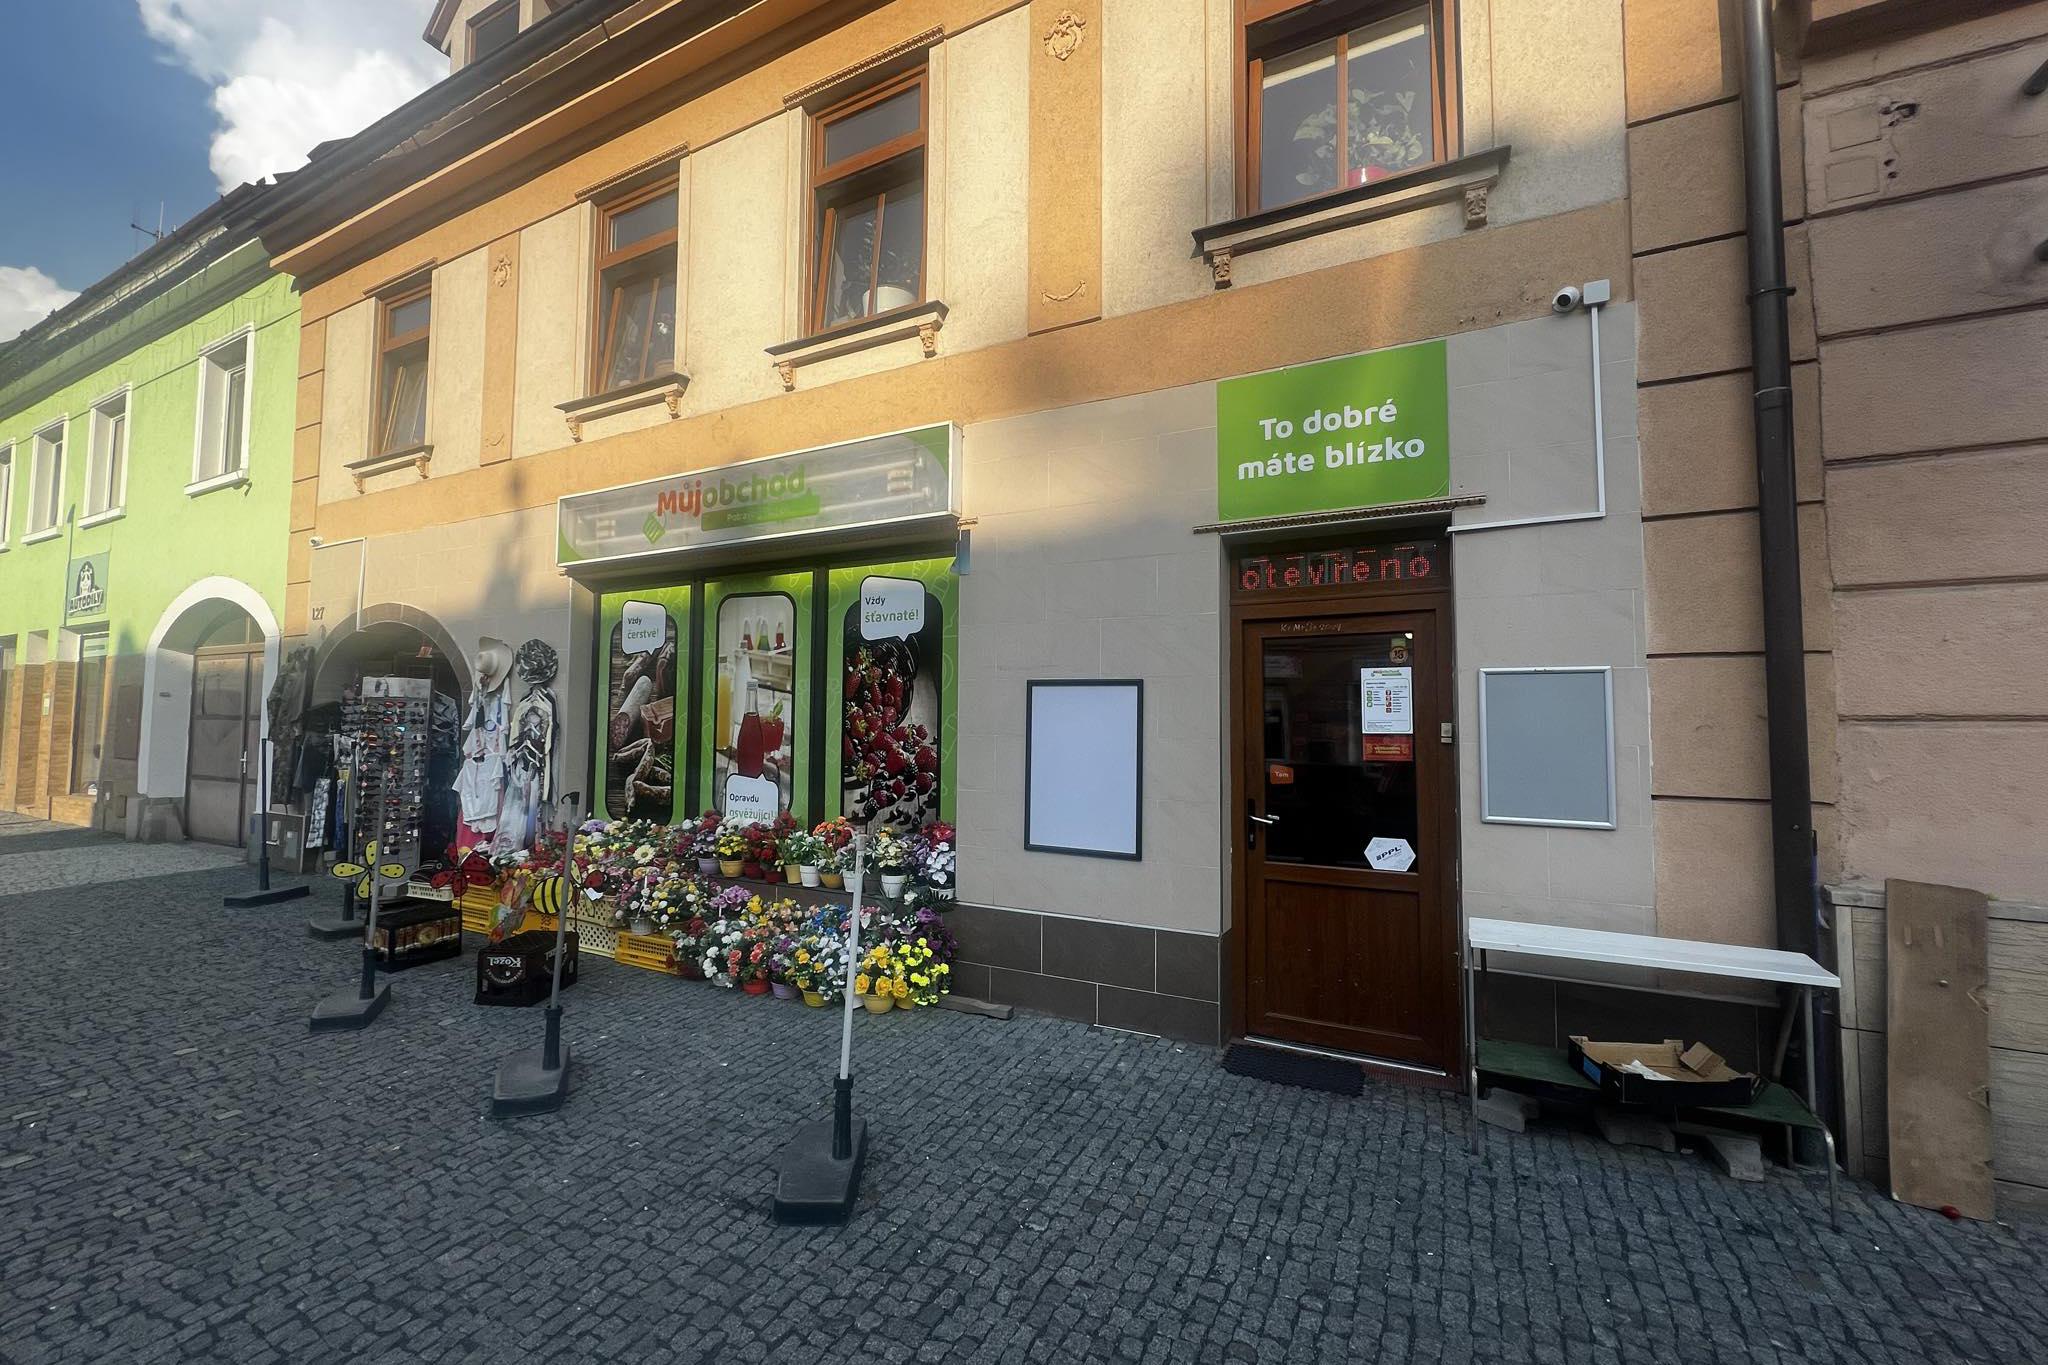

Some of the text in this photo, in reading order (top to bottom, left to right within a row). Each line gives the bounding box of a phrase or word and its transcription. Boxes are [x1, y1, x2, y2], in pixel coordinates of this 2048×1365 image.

[1259, 398, 1398, 441] To dobré
[1238, 436, 1425, 480] máte blízko
[865, 595, 886, 606] Vždy
[312, 606, 325, 620] 127
[865, 608, 919, 623] šťavnaté!
[729, 793, 760, 803] Opravdu
[487, 956, 522, 968] Kozel
